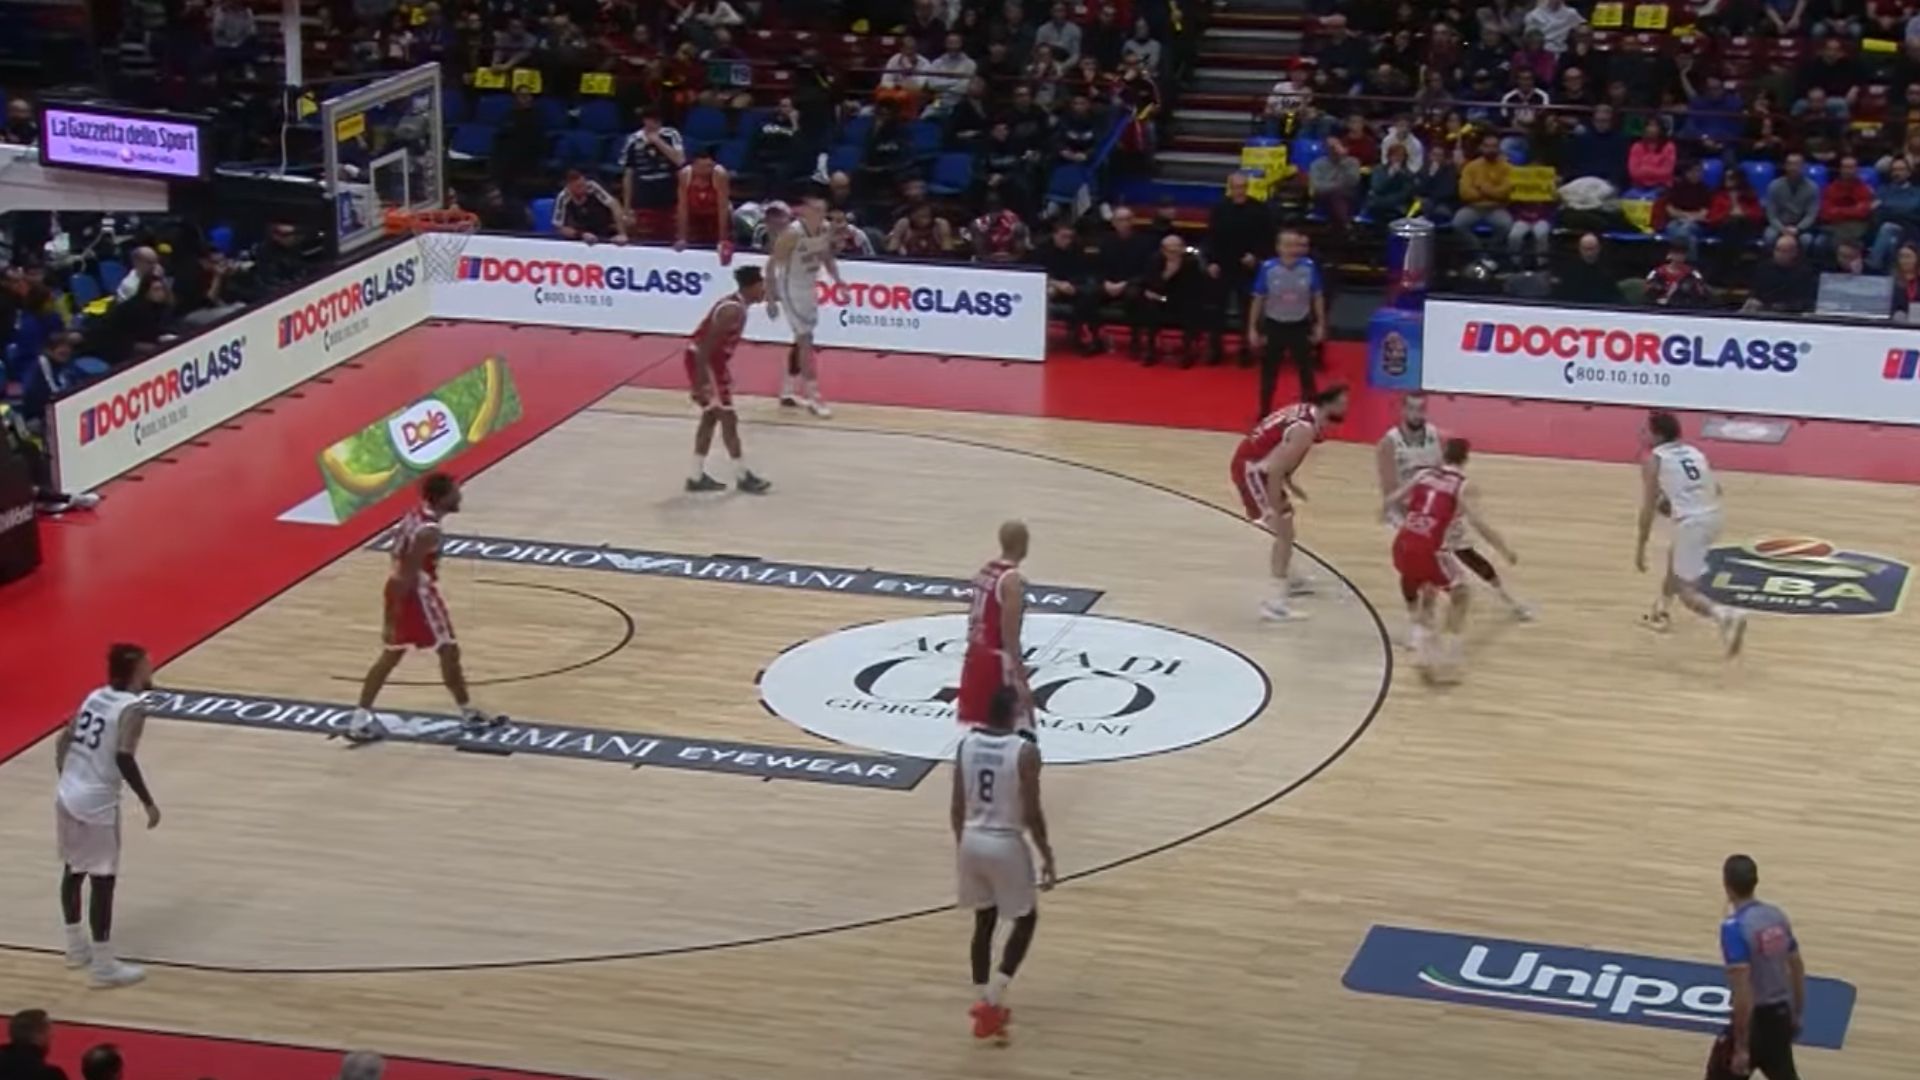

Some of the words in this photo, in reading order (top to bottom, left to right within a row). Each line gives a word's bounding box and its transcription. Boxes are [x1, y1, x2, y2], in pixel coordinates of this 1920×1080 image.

[52, 118, 66, 137] La
[68, 117, 125, 144] Gazzetta
[126, 125, 157, 147] dello
[158, 127, 195, 152] Sport
[814, 280, 1013, 317] OCTORGLASS
[1576, 367, 1671, 387] 800.10.10.10
[402, 409, 447, 446] Dole
[1680, 458, 1700, 480] 6
[1423, 489, 1436, 514] 1
[873, 579, 1067, 607] EYEWAR
[1711, 572, 1876, 601] LBA
[1118, 655, 1184, 676] DI
[74, 710, 106, 750] 23
[677, 745, 898, 781] EYEWEAR
[978, 768, 995, 803] 8
